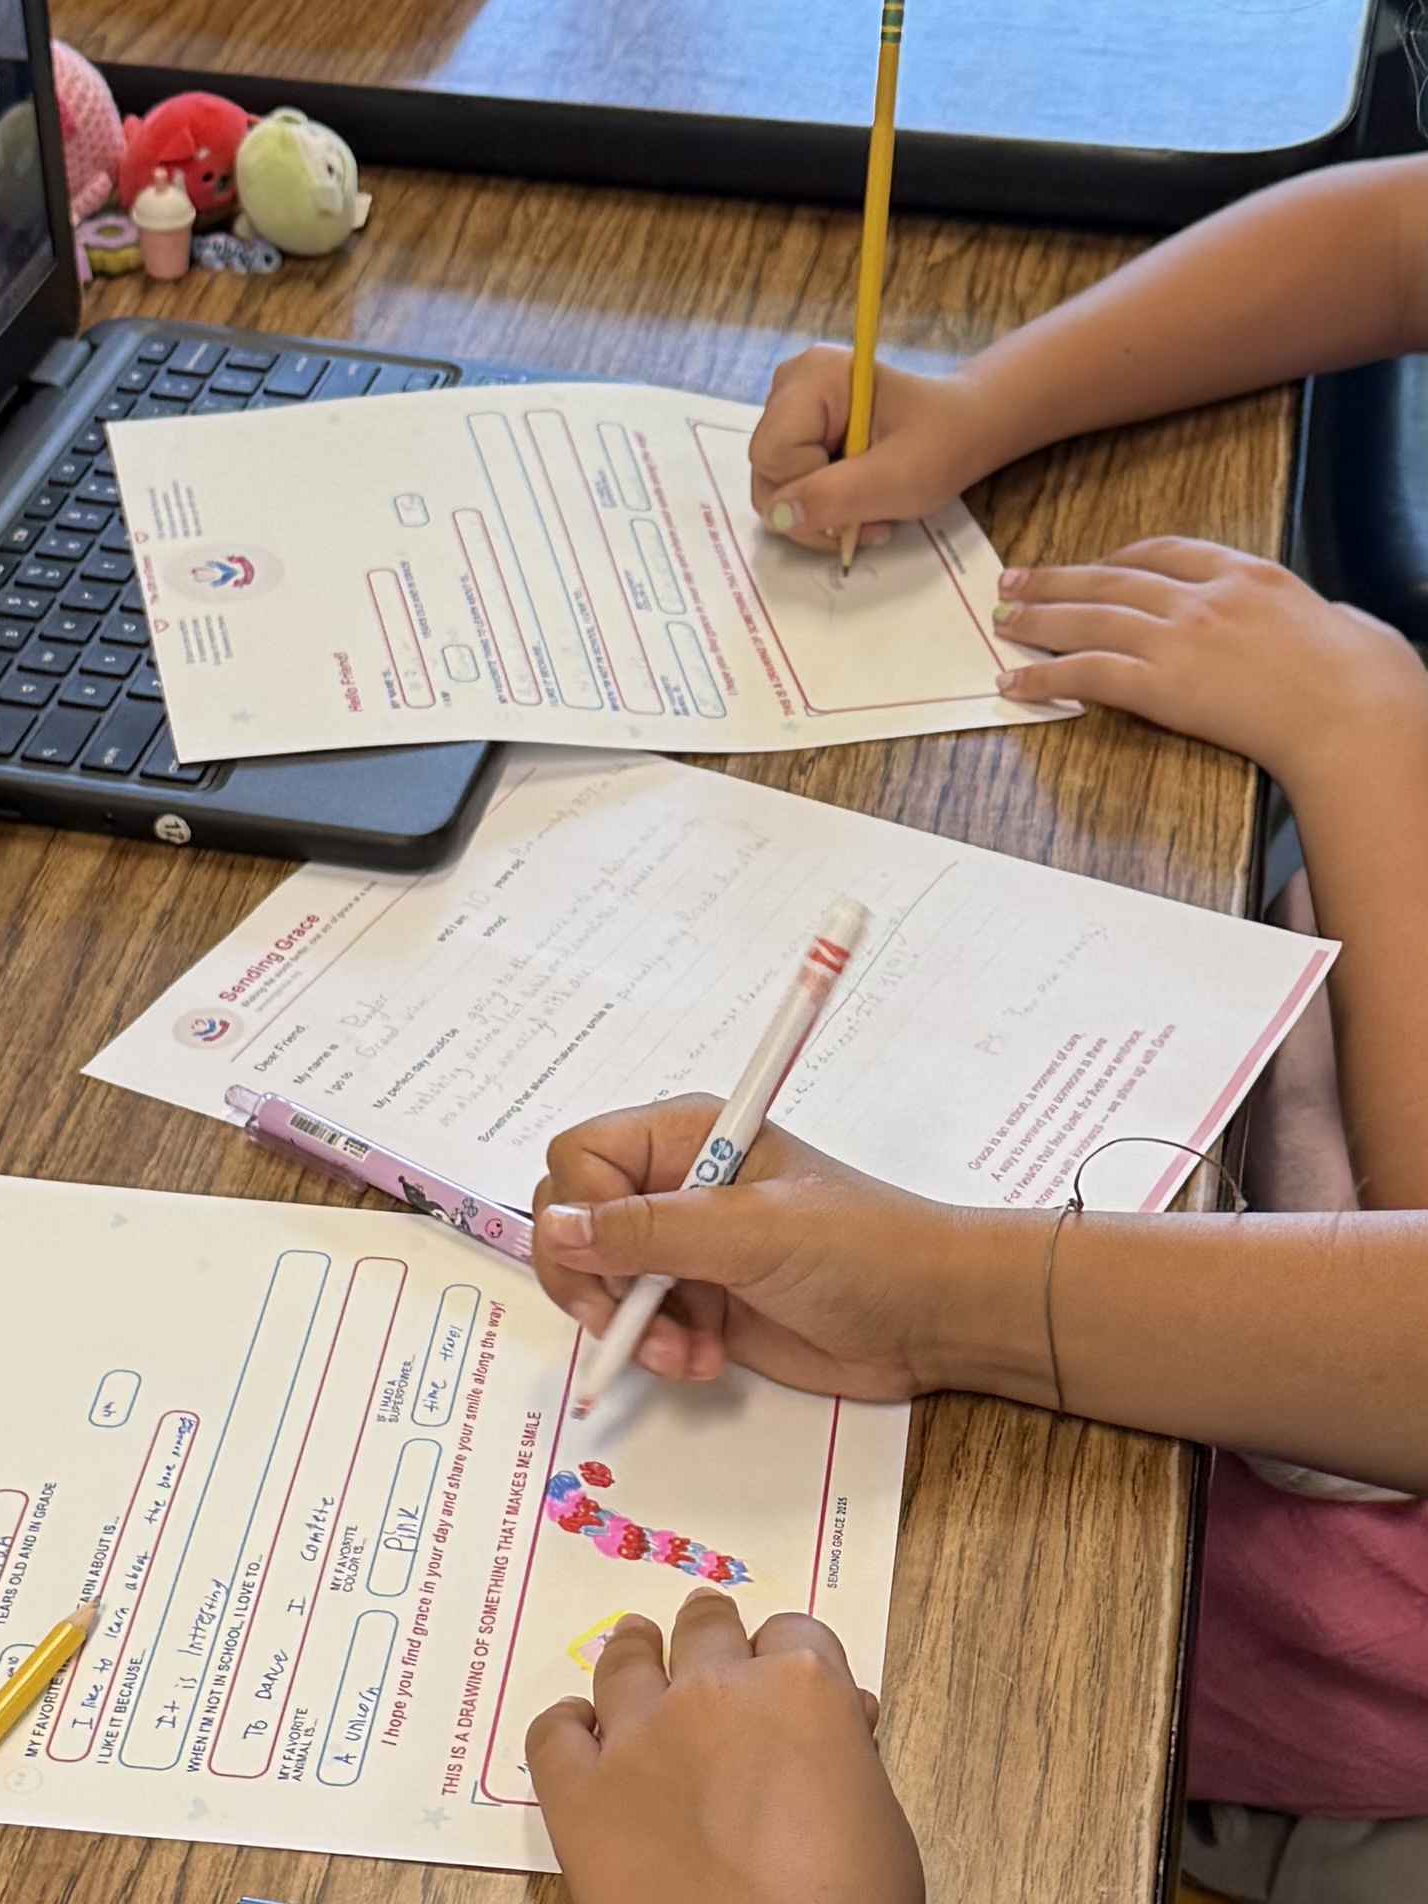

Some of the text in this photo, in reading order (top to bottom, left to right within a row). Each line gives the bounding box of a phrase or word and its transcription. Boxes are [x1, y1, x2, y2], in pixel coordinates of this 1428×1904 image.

[331, 650, 364, 714] Hello Friend!
[217, 913, 321, 1004] Sending Grace
[252, 1023, 308, 1074] Dear Friend,
[291, 1070, 313, 1086] My
[306, 1049, 333, 1074] name
[330, 1078, 347, 1092] go
[486, 1299, 508, 1329] way!
[479, 1329, 498, 1350] the
[470, 1350, 496, 1386] along
[464, 1386, 485, 1422] smile
[456, 1421, 475, 1453] your
[519, 1410, 543, 1449] SMILE
[445, 1452, 469, 1491] share
[514, 1449, 534, 1470] ME
[31, 1481, 59, 1520] GRADE
[440, 1489, 459, 1518] and
[503, 1470, 529, 1517] MAKES
[26, 1519, 44, 1534] IN
[430, 1517, 455, 1545] day
[495, 1517, 519, 1553] THAT
[825, 1495, 849, 1590] SENDING GRACE 2025
[16, 1533, 38, 1561] AND
[328, 1525, 360, 1592] MY FAVORITE
[340, 1535, 369, 1594] COLOR IS...
[424, 1544, 445, 1580] your
[7, 1560, 29, 1587] OLD
[243, 1554, 264, 1579] TO...
[233, 1579, 257, 1613] LOVE
[417, 1579, 438, 1595] in
[477, 1554, 510, 1636] SOMETHING
[410, 1596, 434, 1638] grace
[216, 1619, 246, 1673] SCHOOL,
[399, 1636, 423, 1668] find
[472, 1636, 491, 1658] OF
[111, 1648, 148, 1715] BECAUSE...
[211, 1673, 229, 1688] IN
[395, 1669, 416, 1699] you
[455, 1659, 487, 1729] DRAWING
[23, 1675, 65, 1758] MY FAVORITE
[153, 1699, 182, 1730] It
[173, 1675, 199, 1690] is
[202, 1687, 225, 1716] NOT
[382, 1699, 409, 1739] hope
[107, 1714, 125, 1729] IT
[197, 1715, 216, 1734] I'M
[97, 1729, 121, 1759] LIKE
[184, 1734, 210, 1774] WHEN
[275, 1706, 310, 1781] MY FAVORITE
[448, 1744, 468, 1761] IS
[440, 1762, 465, 1797] THIS
